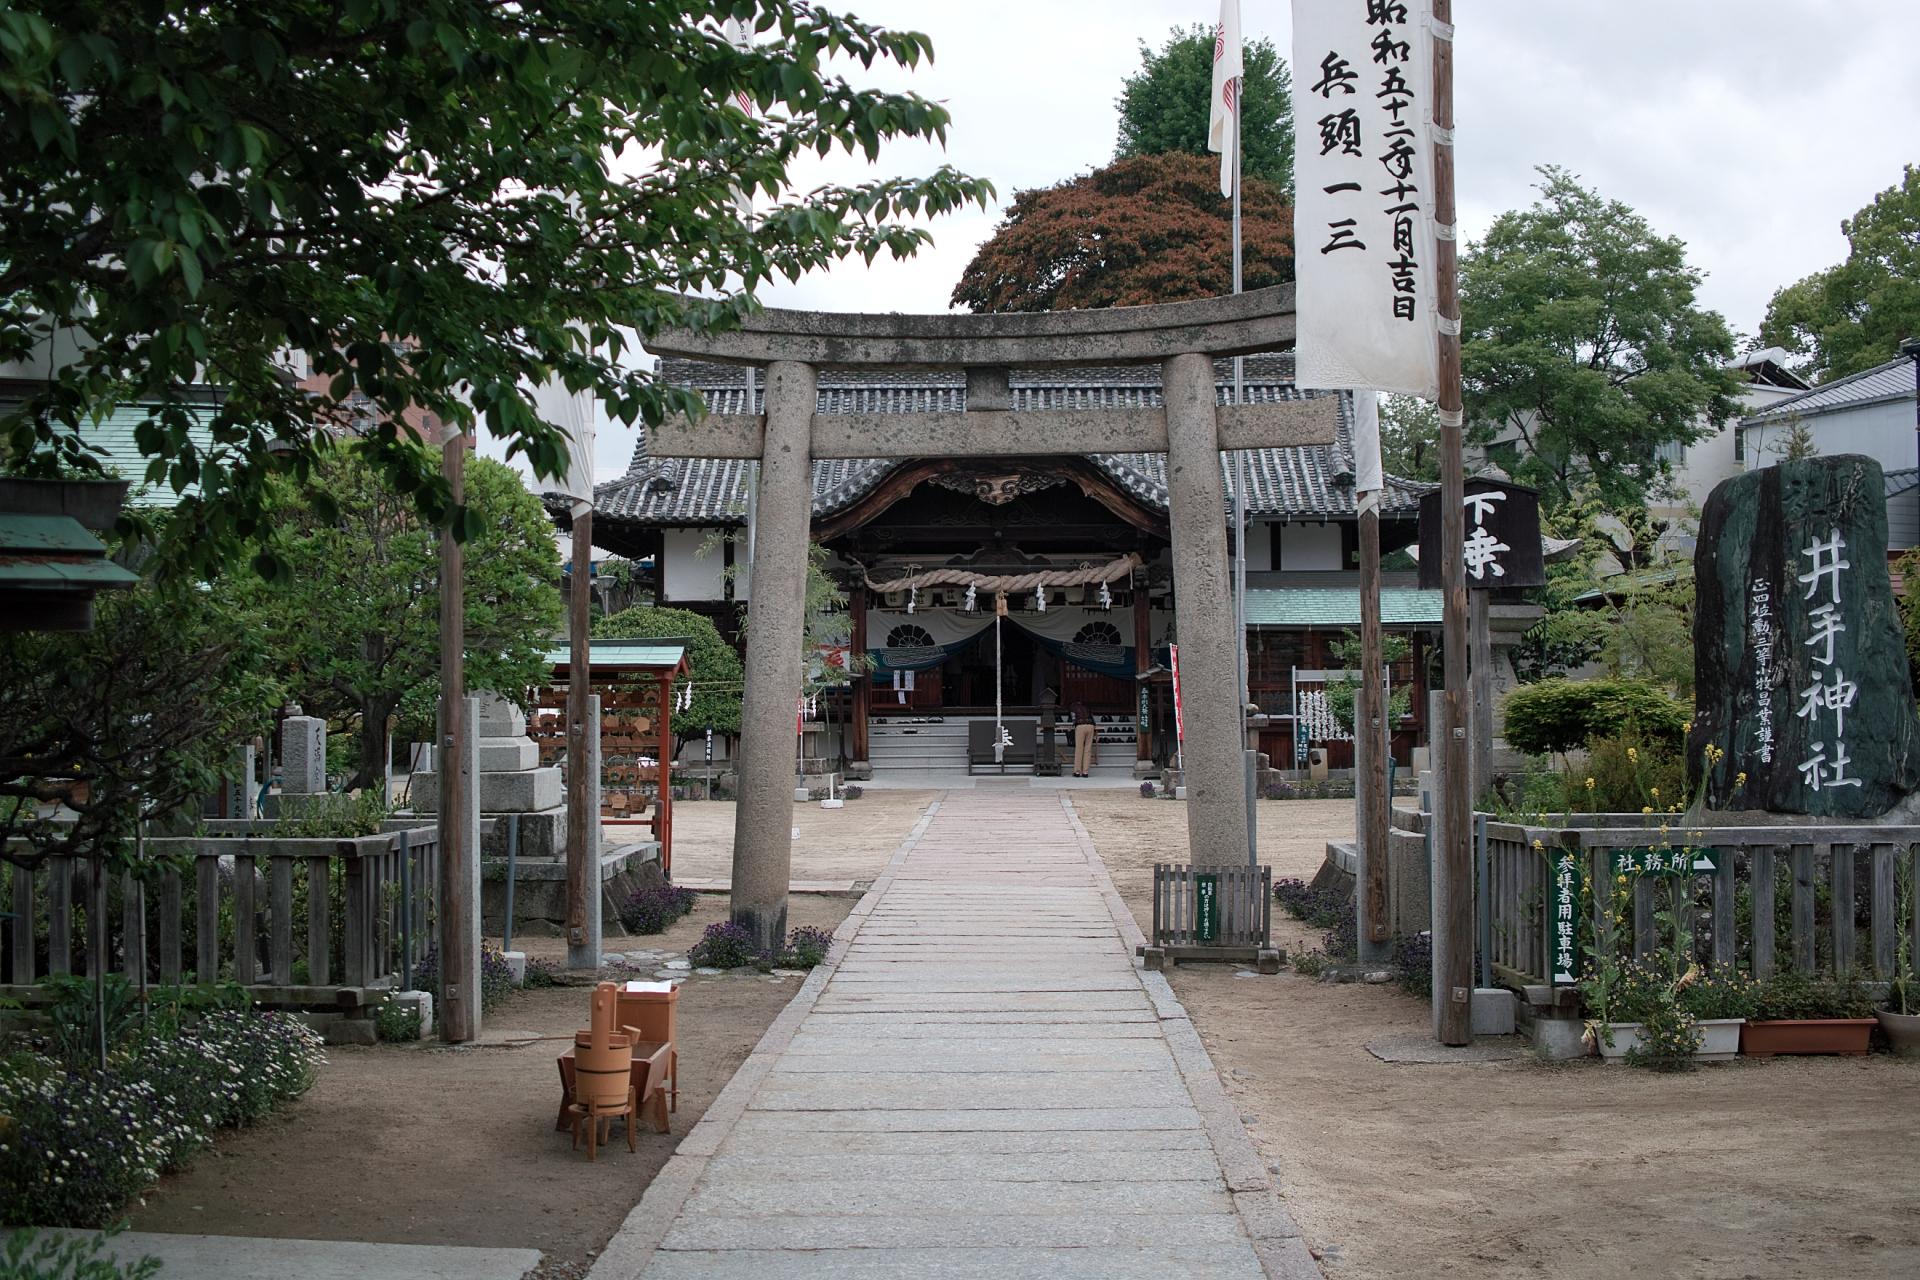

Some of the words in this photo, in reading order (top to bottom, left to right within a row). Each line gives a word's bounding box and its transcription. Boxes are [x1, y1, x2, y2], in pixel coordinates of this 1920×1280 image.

[1311, 50, 1366, 255] 兵頭一三
[1797, 527, 1862, 792] 井手神社
[1556, 855, 1575, 968] 参拝者用駐車場
[1617, 853, 1688, 873] 社務所
